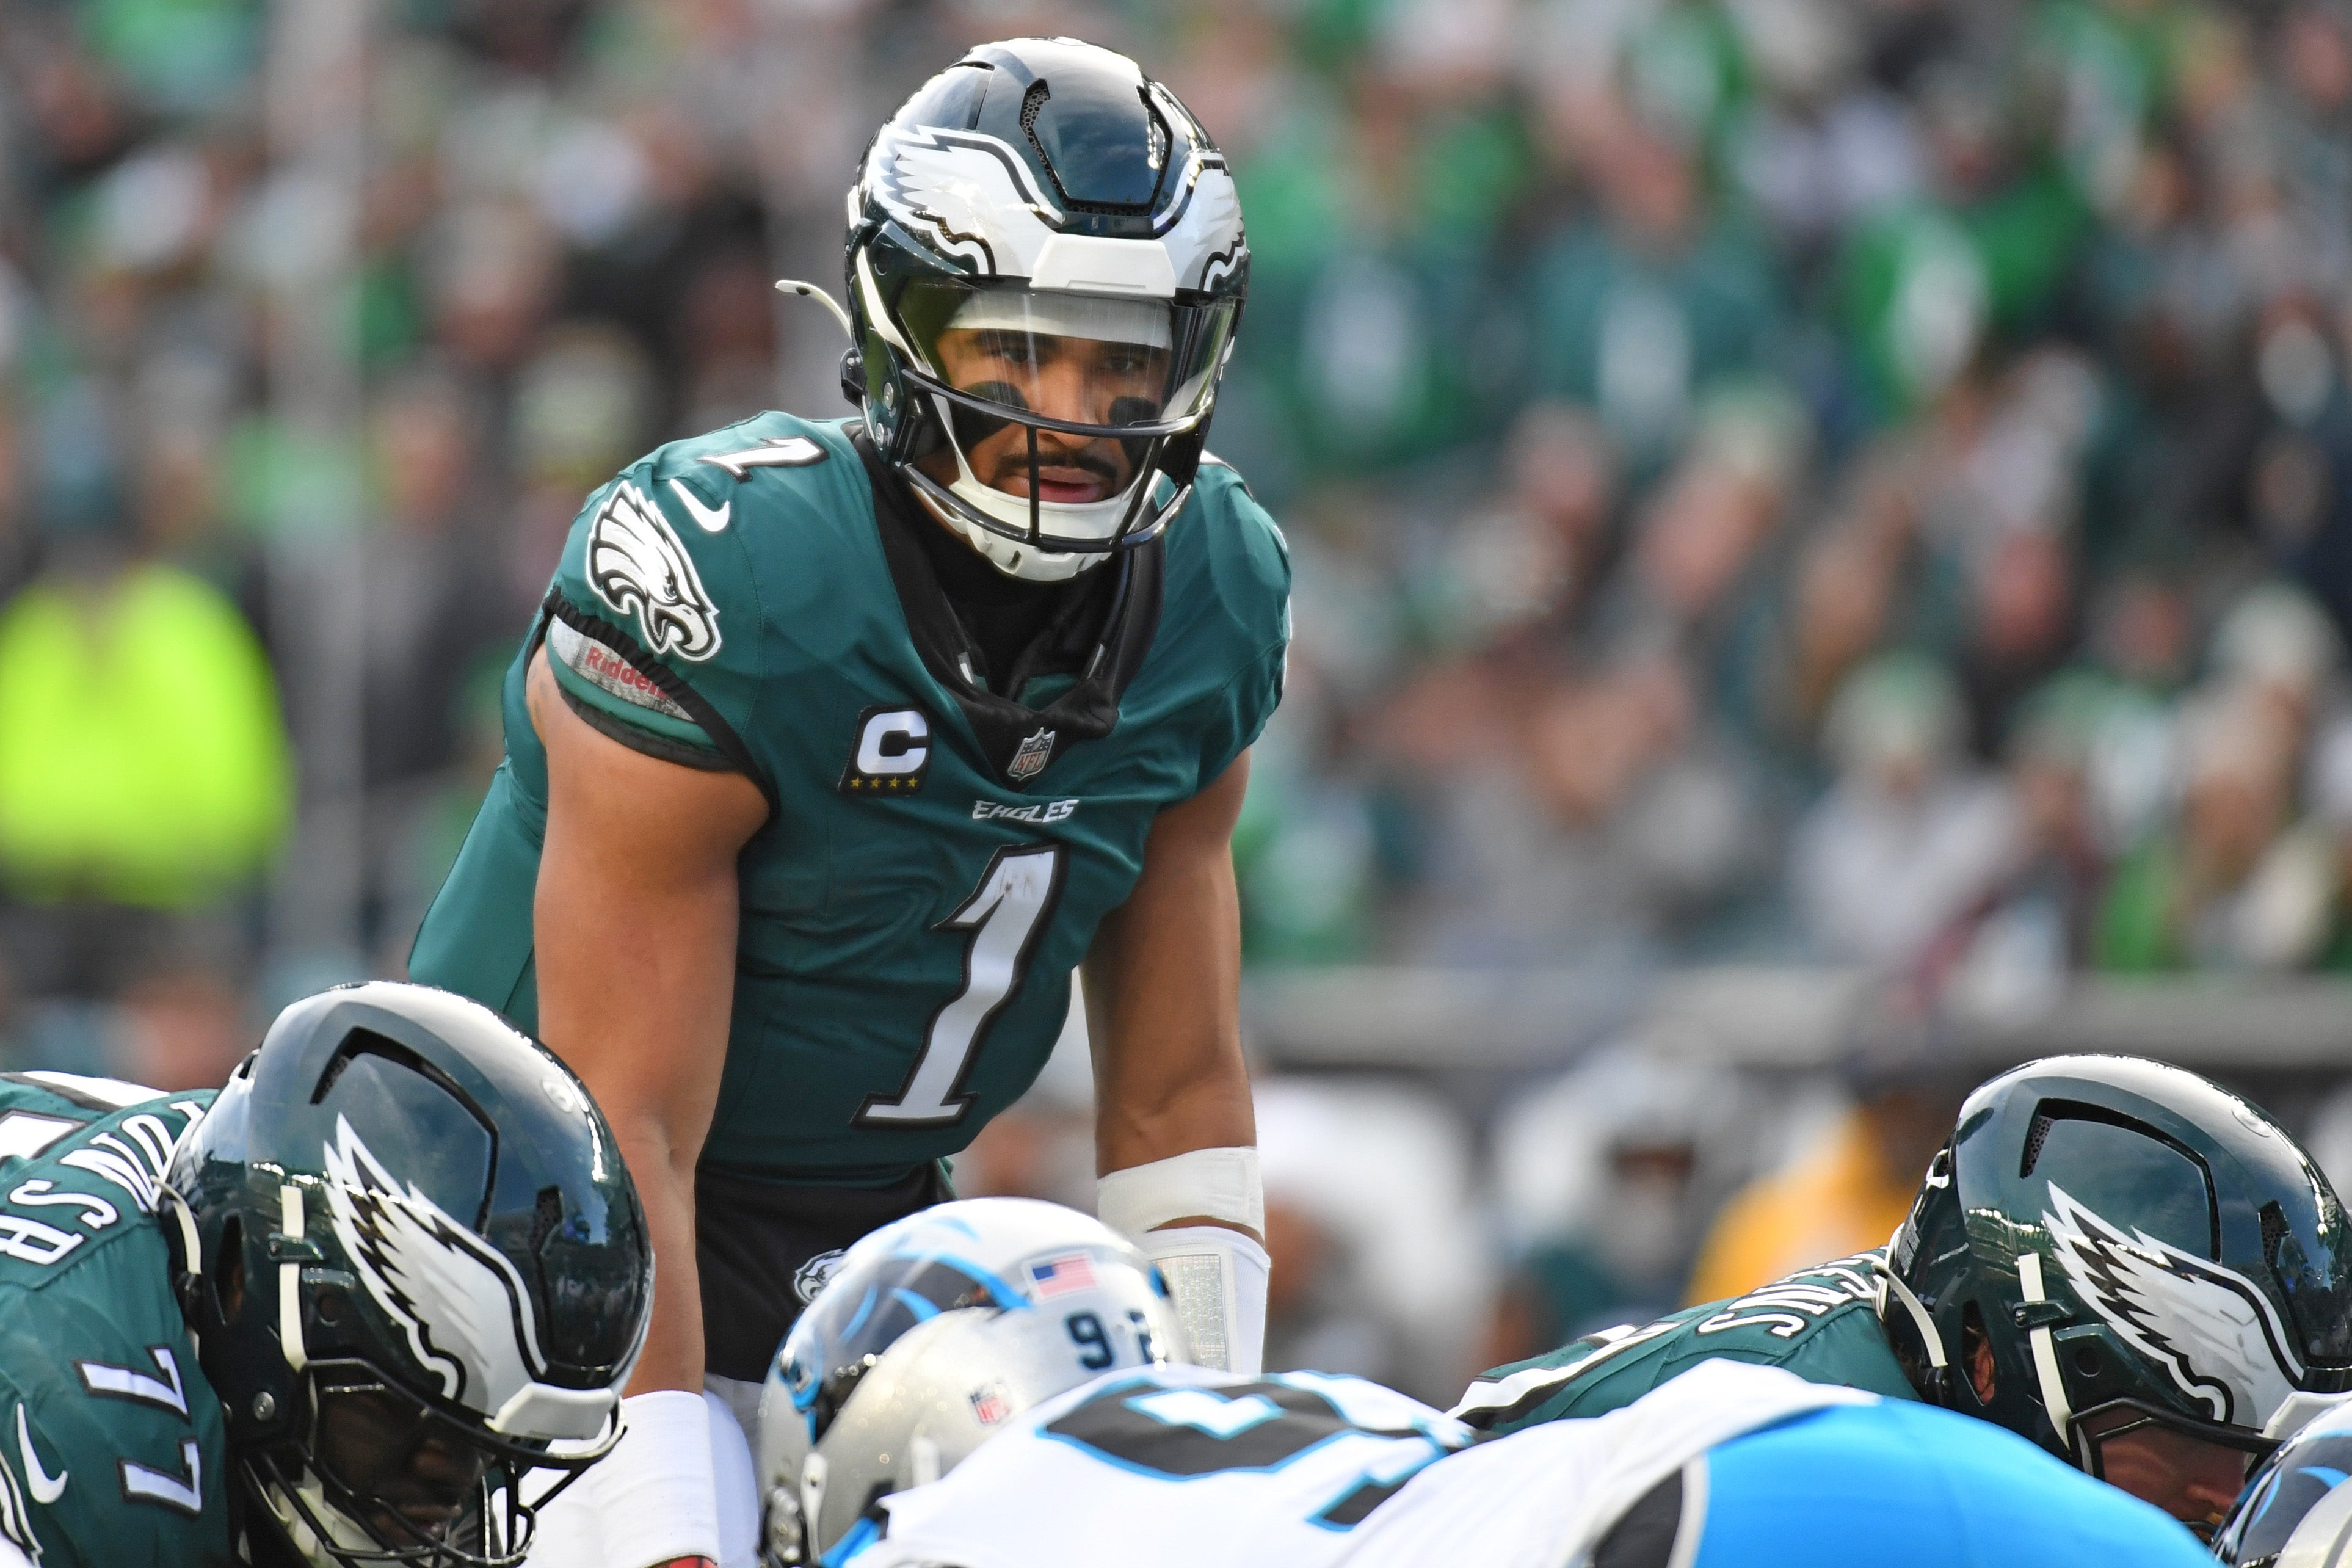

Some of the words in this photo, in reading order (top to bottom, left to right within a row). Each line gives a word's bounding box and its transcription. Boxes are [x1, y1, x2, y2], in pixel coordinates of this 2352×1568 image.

[585, 646, 669, 700] Ridde
[856, 709, 929, 775] C
[972, 799, 1080, 823] EAGLES
[855, 846, 1064, 1123] 1
[75, 1345, 204, 1518] 77
